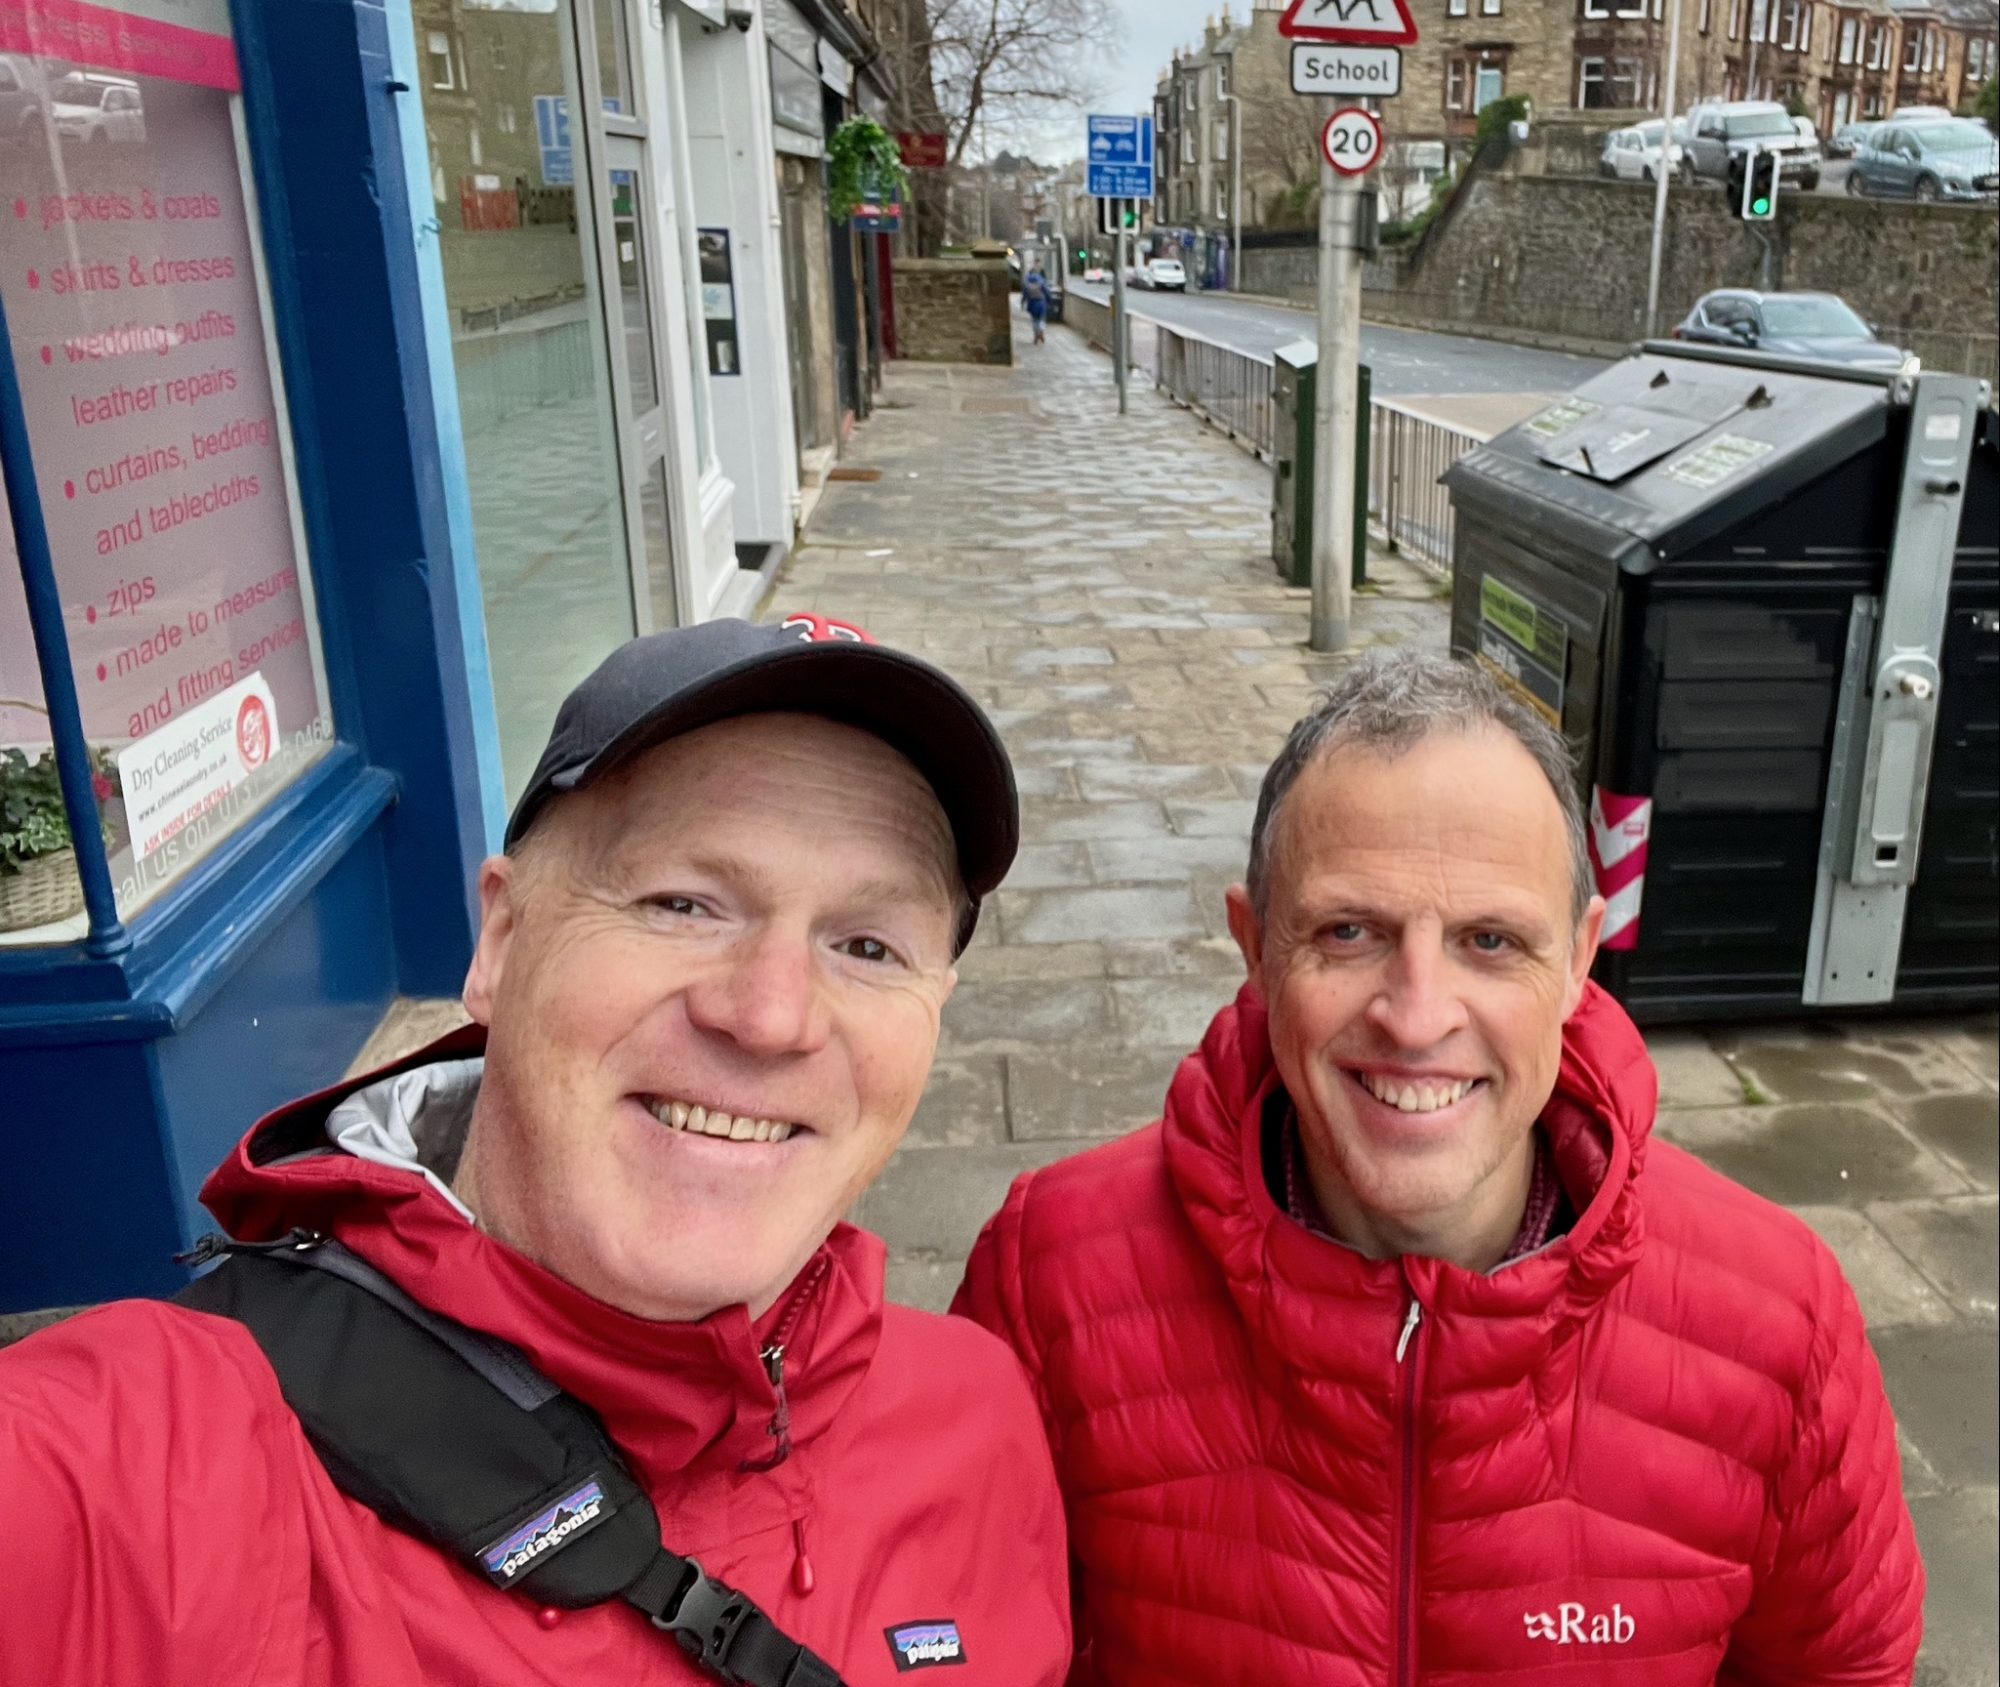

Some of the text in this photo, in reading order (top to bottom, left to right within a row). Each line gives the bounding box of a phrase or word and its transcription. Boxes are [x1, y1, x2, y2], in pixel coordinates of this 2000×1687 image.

[1306, 57, 1389, 82] School
[1333, 128, 1372, 155] 20
[41, 189, 221, 231] jackets & coats
[51, 254, 236, 295] skirts & dresses
[63, 308, 236, 363] wedding outfits
[72, 366, 237, 427] leather repairs
[85, 417, 270, 495] curtains, bedding
[96, 474, 261, 556] and tablecloths
[107, 575, 156, 618] zips
[116, 624, 182, 678] made
[187, 611, 208, 638] to
[129, 619, 303, 738] and fitting service
[132, 715, 233, 793] Dry Cleaning Service
[114, 861, 147, 907] all
[154, 839, 180, 878] us
[502, 1499, 601, 1578] patagonia
[1557, 1601, 1635, 1645] Rab
